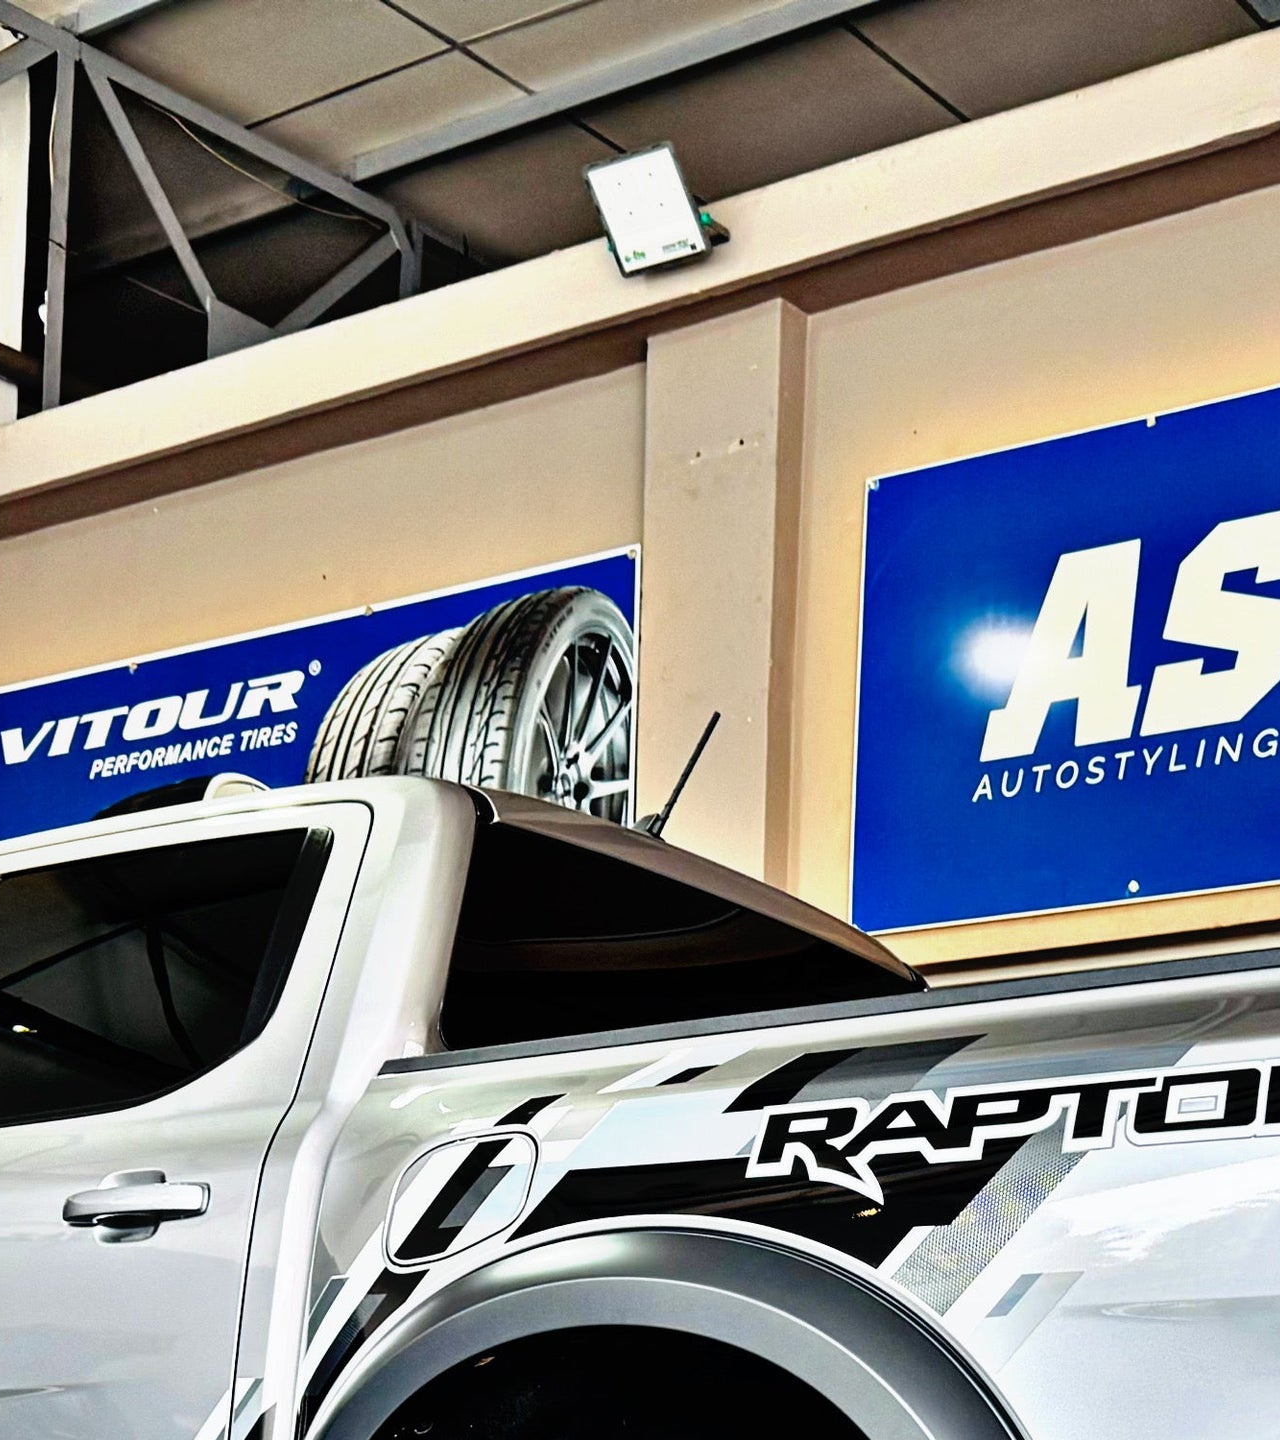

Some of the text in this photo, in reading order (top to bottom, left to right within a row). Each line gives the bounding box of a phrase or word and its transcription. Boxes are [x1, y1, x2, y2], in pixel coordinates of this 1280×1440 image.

[0, 669, 306, 765] VITOUR
[88, 721, 299, 779] PERFORMANCE TIRES
[971, 728, 1280, 803] AUTOSTYLING
